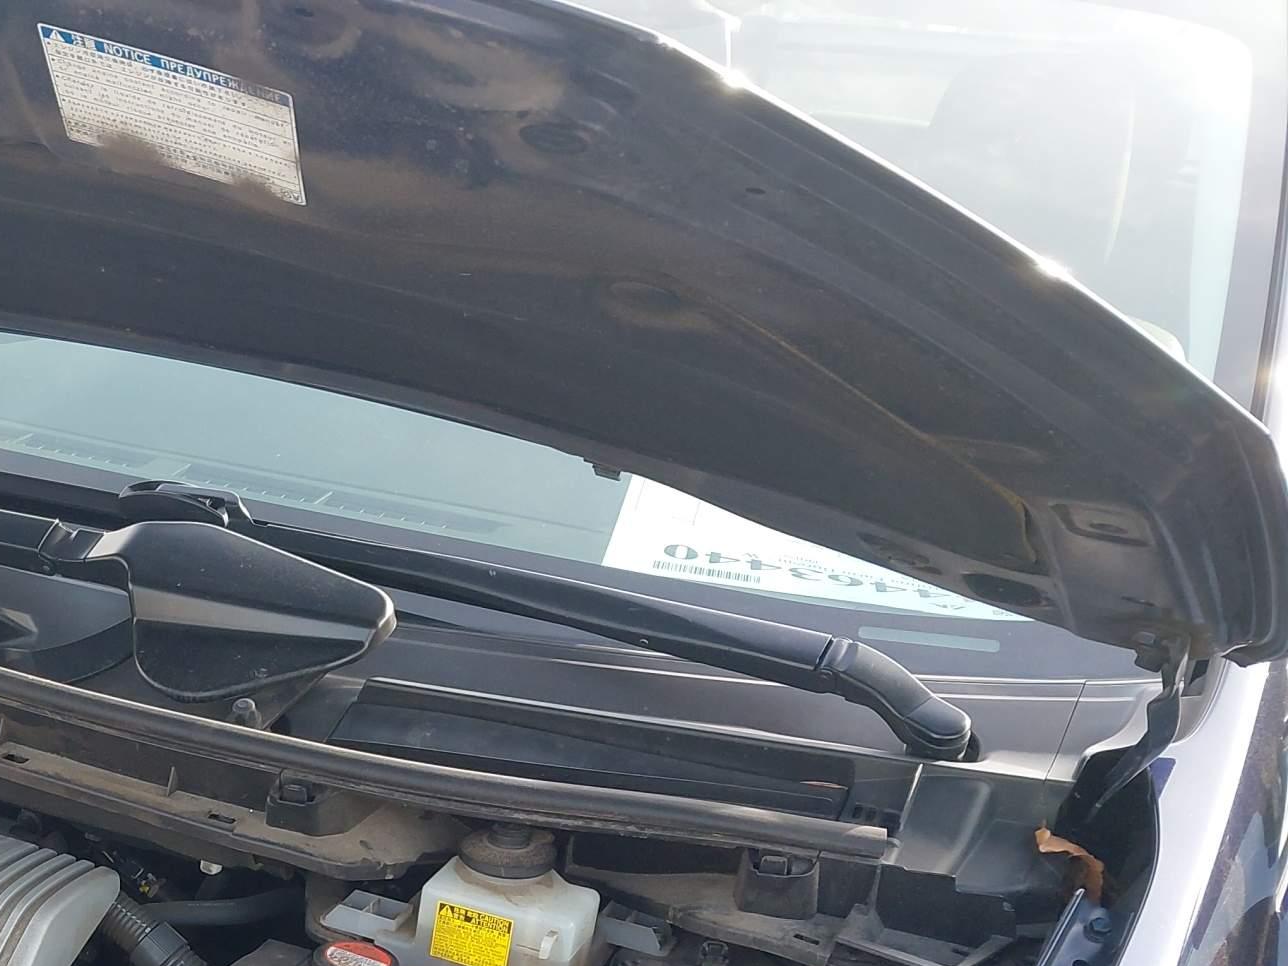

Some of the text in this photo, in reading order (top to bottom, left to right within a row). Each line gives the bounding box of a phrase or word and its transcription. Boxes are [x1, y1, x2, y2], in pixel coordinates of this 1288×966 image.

[103, 42, 152, 65] NOTICE
[663, 544, 952, 599] 4463440
[479, 914, 510, 928] CAUTION
